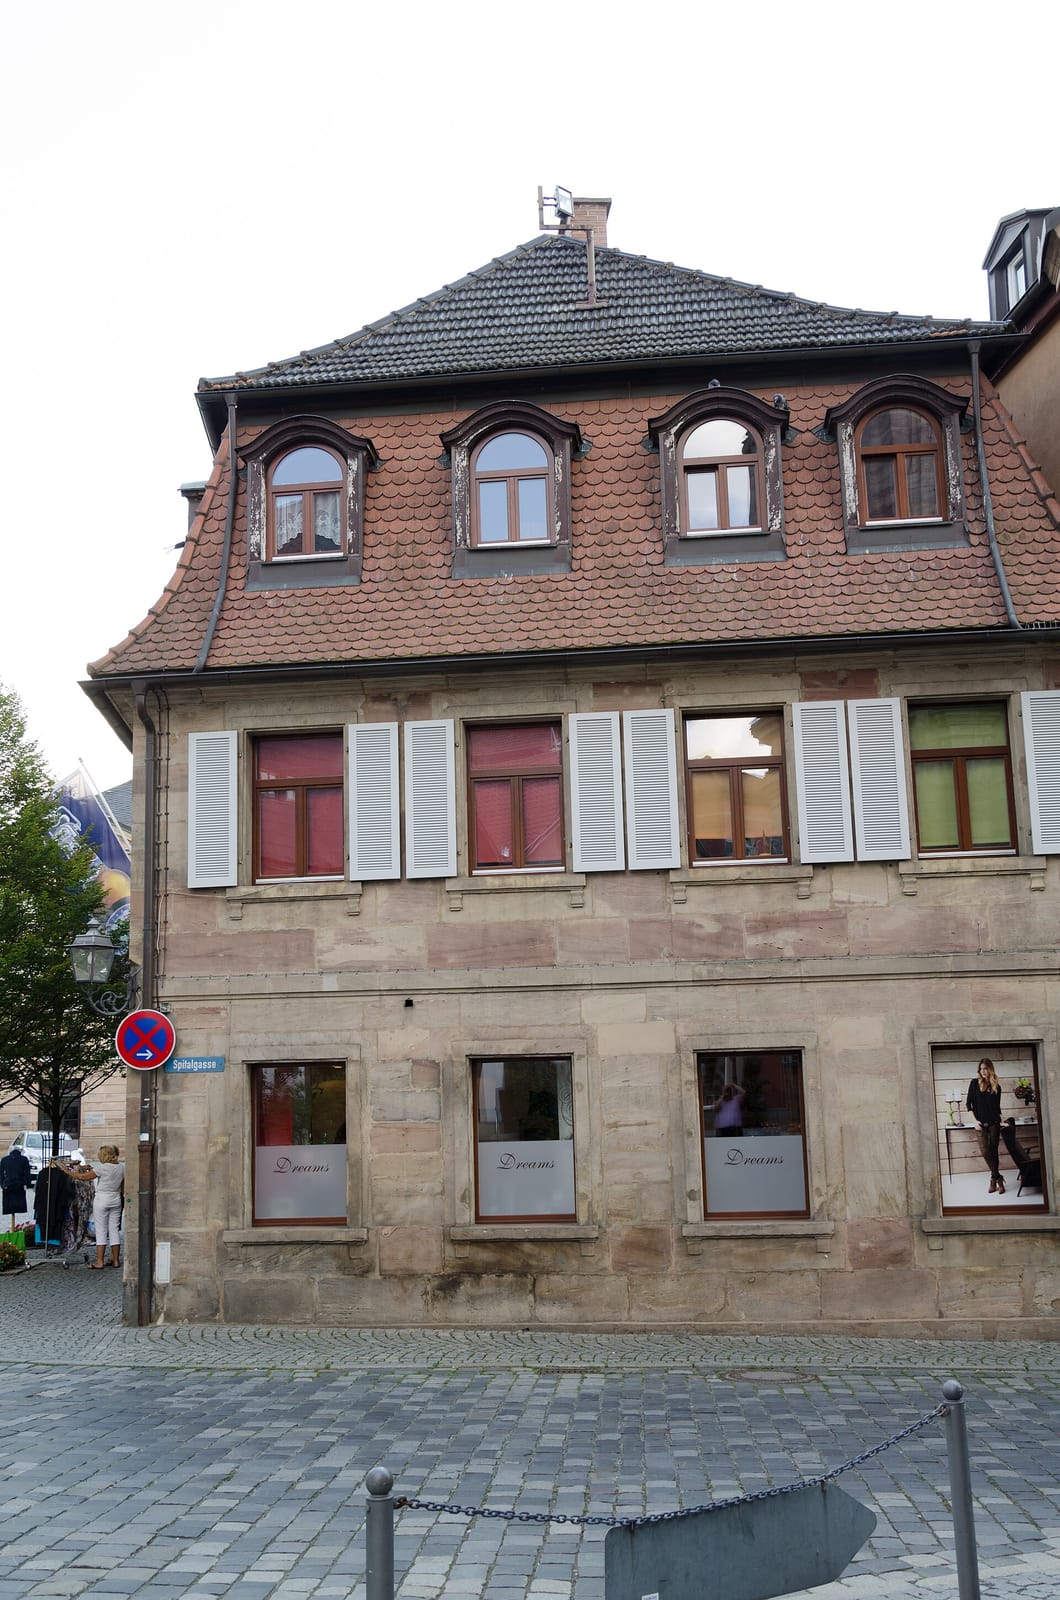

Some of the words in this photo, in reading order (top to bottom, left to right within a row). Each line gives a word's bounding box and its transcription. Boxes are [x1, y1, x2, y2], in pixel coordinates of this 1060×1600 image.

[172, 1060, 217, 1071] Spitalgasse
[274, 1157, 330, 1174] Dreams
[497, 1153, 555, 1170] Dreams
[724, 1148, 784, 1166] Dreams
